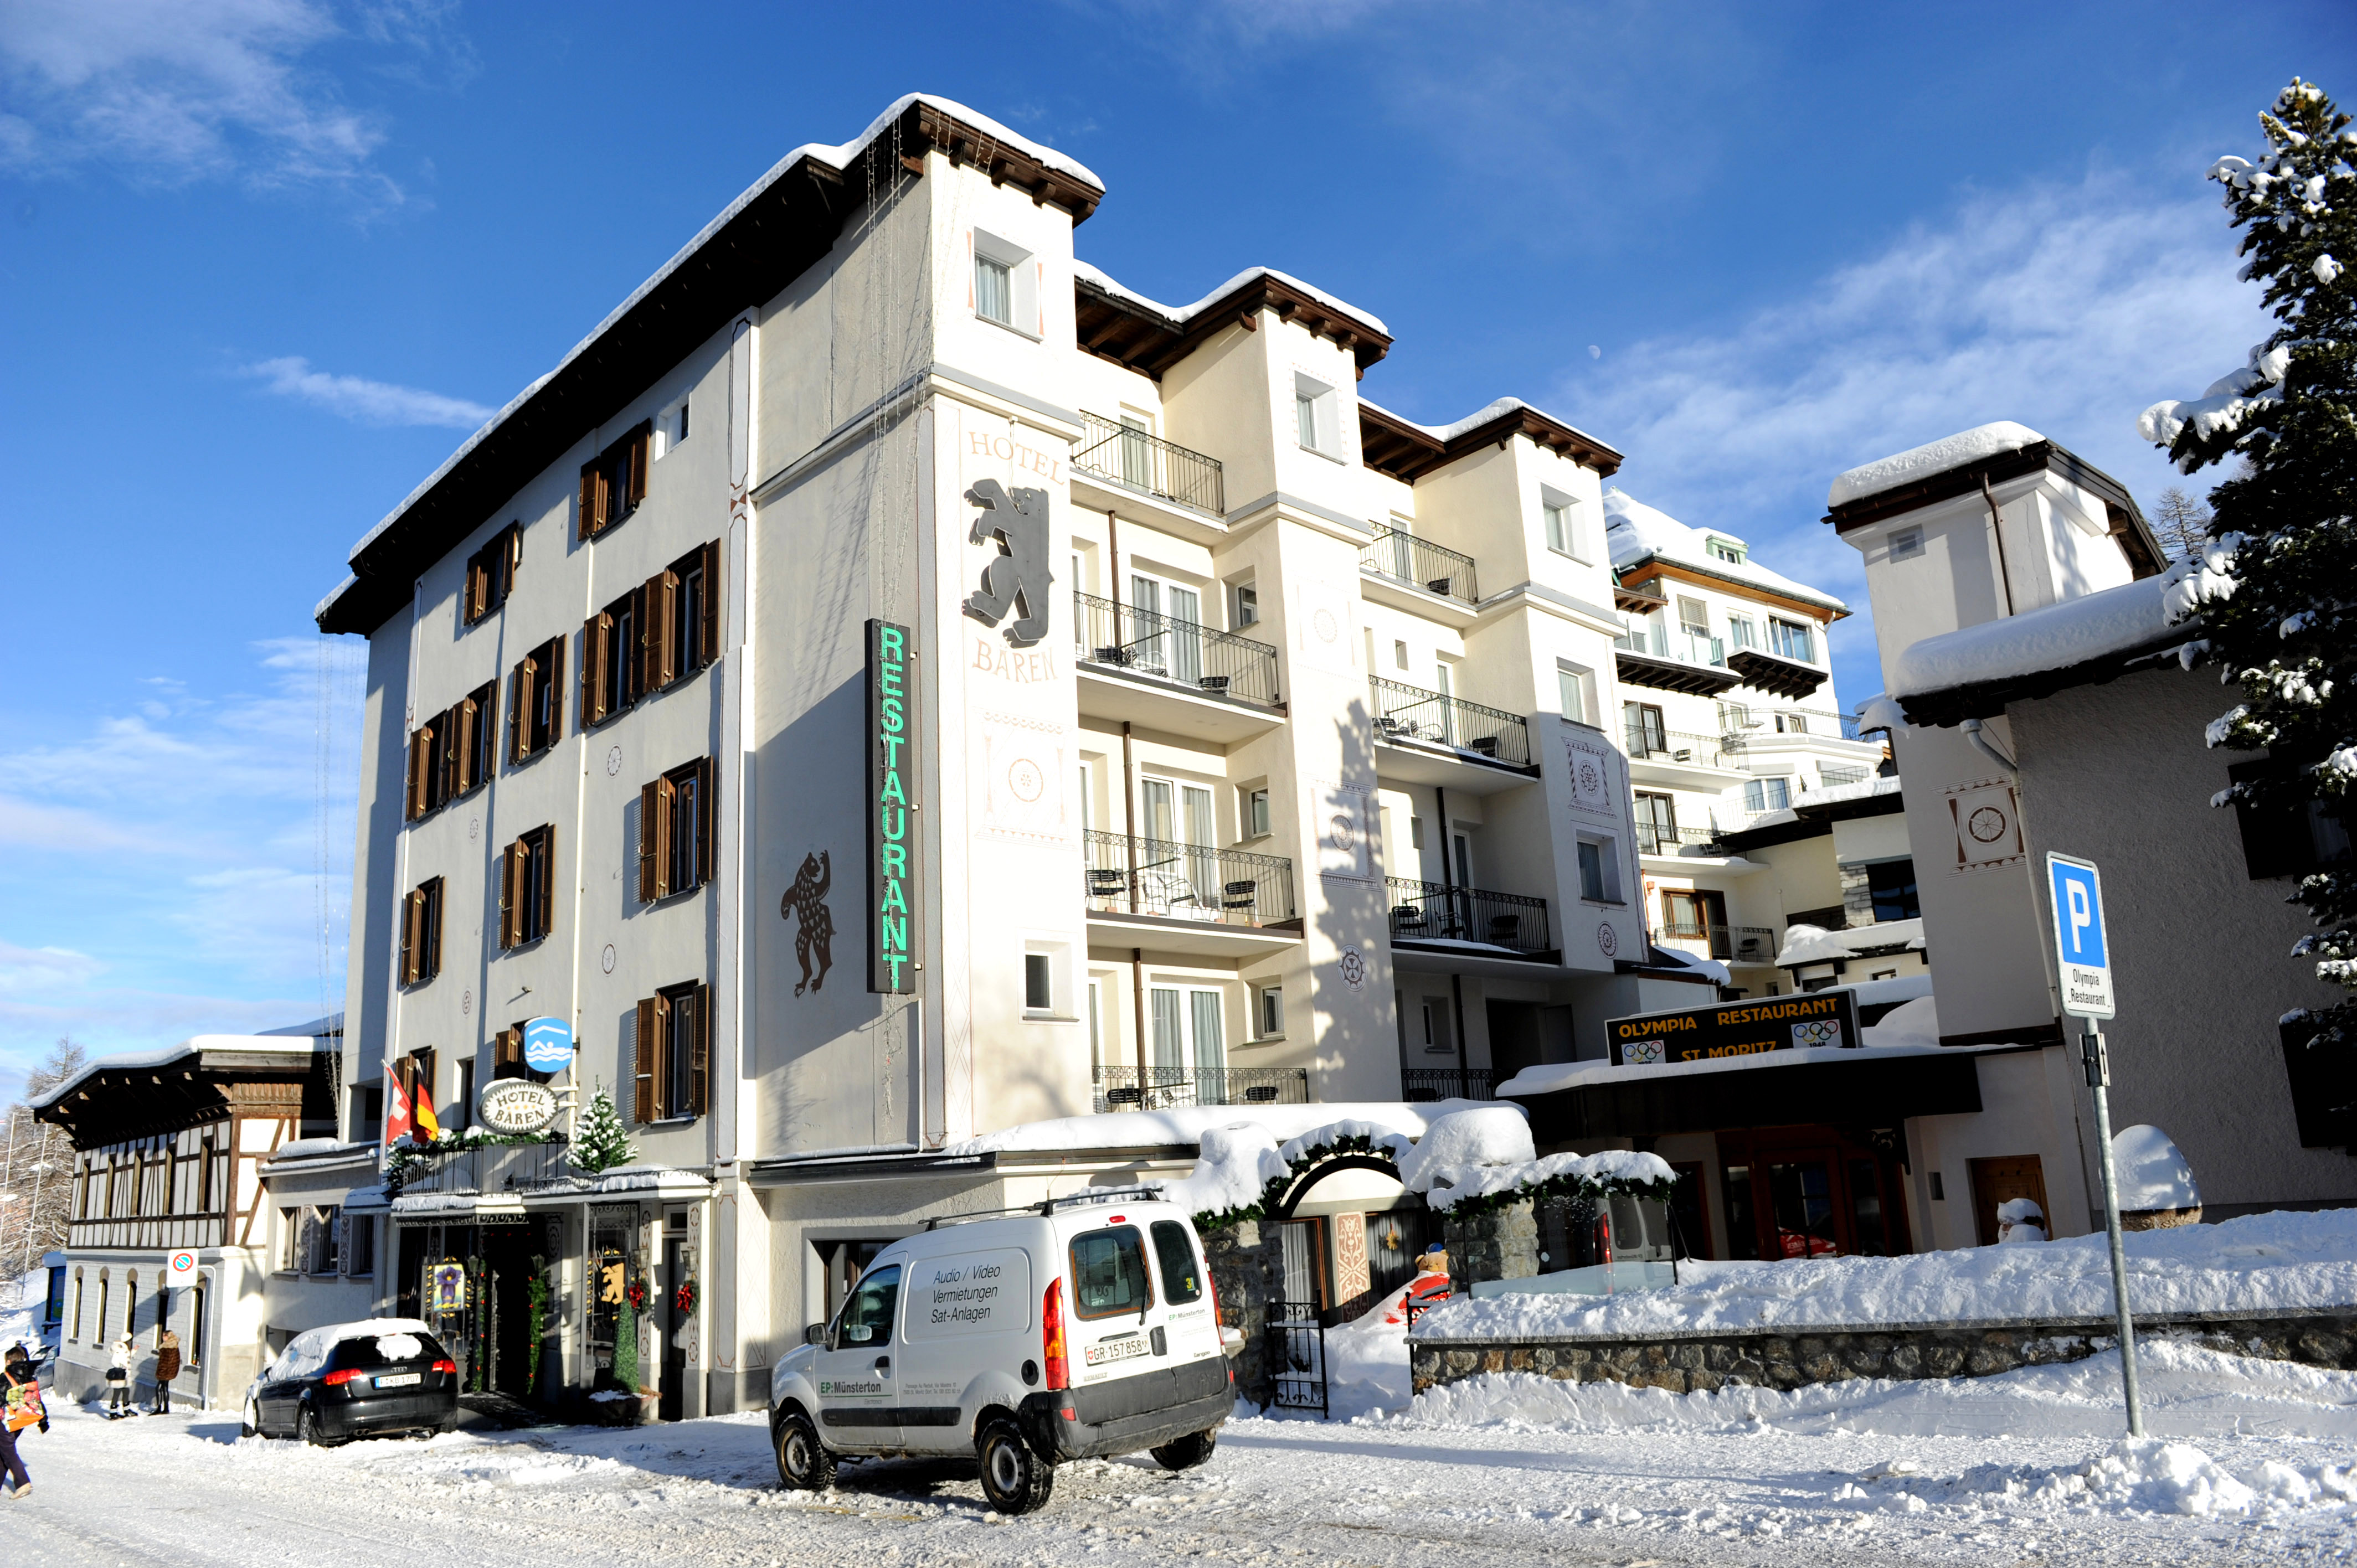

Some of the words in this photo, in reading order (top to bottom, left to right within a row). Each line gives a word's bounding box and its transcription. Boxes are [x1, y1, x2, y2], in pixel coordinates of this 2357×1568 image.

[968, 431, 1065, 486] HOTEL
[971, 636, 1058, 684] BÄREN
[880, 626, 908, 991] RESTAURANT
[2065, 878, 2091, 954] P
[2072, 968, 2099, 988] Olympia
[2070, 988, 2106, 1007] Restaurant
[1618, 1016, 1697, 1038] OLYMPIA
[1717, 997, 1838, 1026] RESTAURANT
[1708, 1040, 1777, 1059] MORITZ
[496, 1091, 545, 1107] HOTEL
[933, 1268, 961, 1285] Audio
[973, 1263, 1001, 1280] Video
[933, 1286, 998, 1304] Vermietungen
[931, 1306, 990, 1323] Sat-Anlagen
